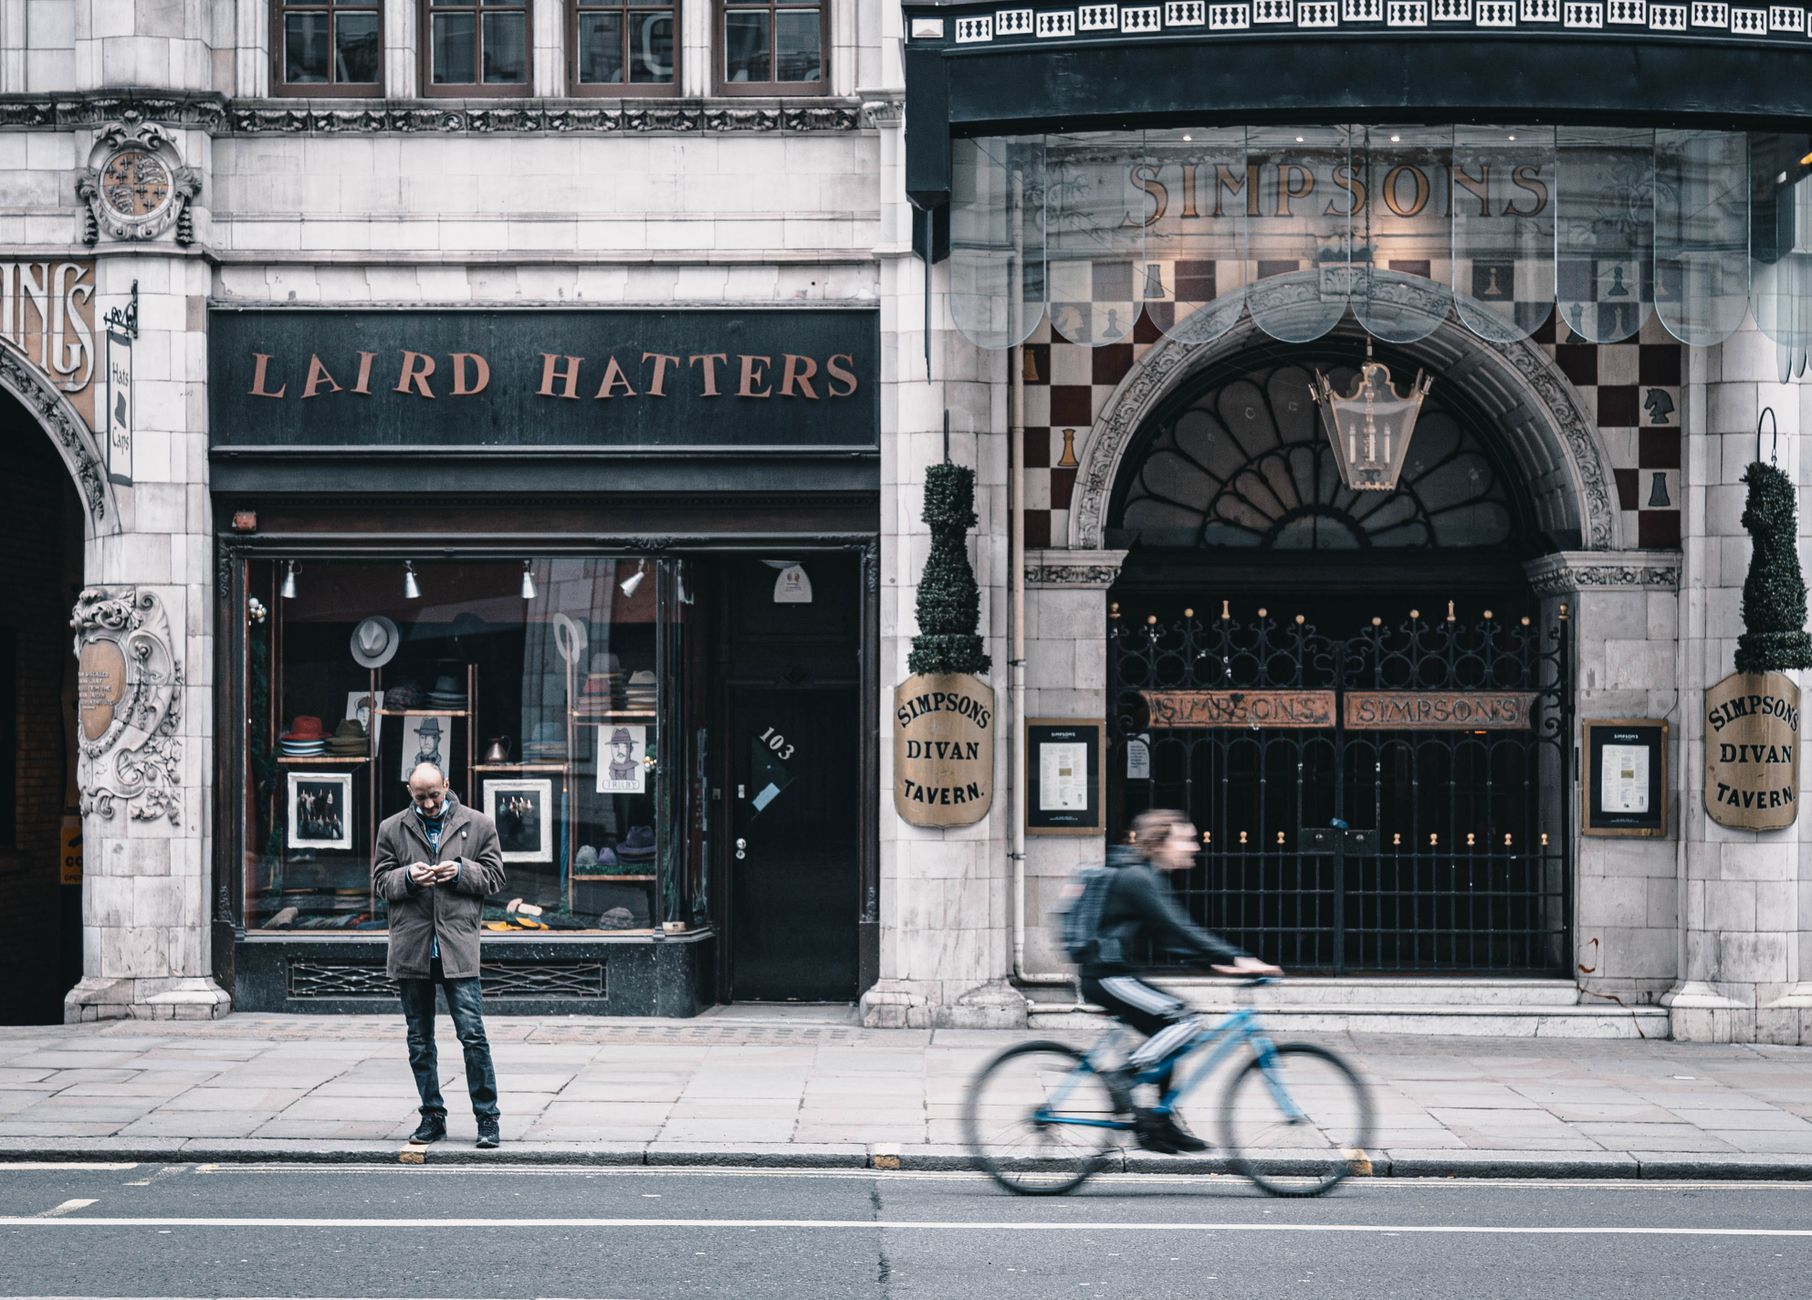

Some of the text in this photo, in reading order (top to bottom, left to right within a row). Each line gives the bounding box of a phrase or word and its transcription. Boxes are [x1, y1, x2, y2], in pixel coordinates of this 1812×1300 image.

[1118, 163, 1549, 228] SIMPSONS
[112, 361, 129, 388] Hats
[247, 349, 858, 399] LAIRD HATTERS
[112, 426, 130, 456] Caps
[759, 726, 795, 760] 103
[906, 739, 980, 760] DIVAN
[1719, 743, 1793, 764] DIVAN
[904, 779, 985, 806] TAVERN.
[1717, 781, 1796, 809] TAVERN.
